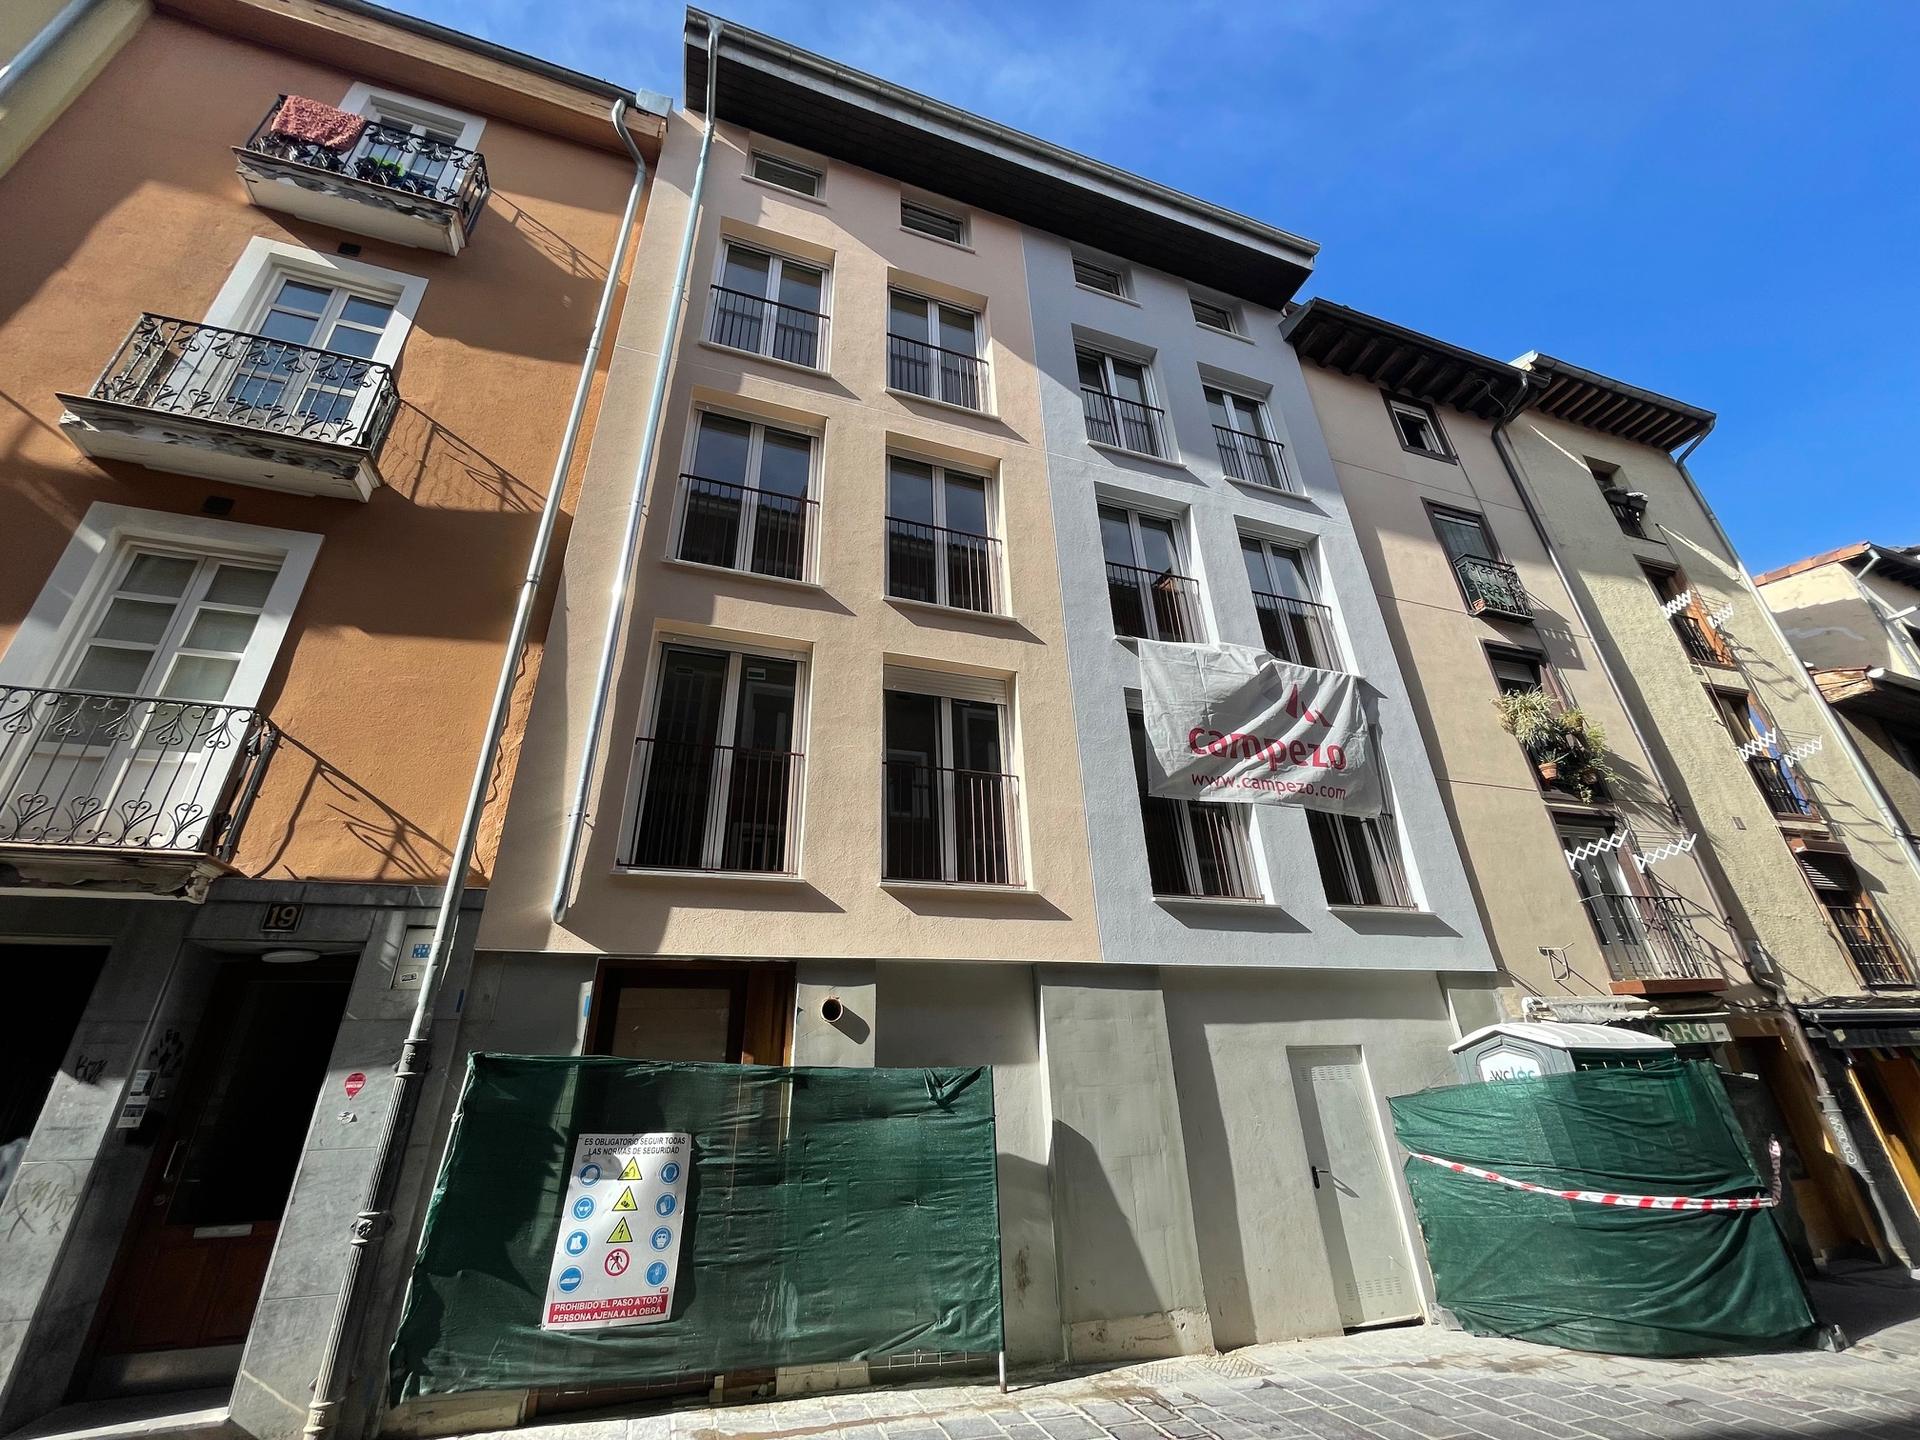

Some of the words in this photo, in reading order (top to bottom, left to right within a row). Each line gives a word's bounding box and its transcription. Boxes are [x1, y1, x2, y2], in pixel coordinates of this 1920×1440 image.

[1188, 727, 1347, 771] campezo
[1191, 772, 1347, 800] www.campezo.com
[266, 906, 298, 927] 19
[584, 1138, 593, 1146] ES
[594, 1138, 639, 1146] OBLIGATORIO
[640, 1137, 663, 1145] SEGUIR
[665, 1137, 686, 1145] TODAS
[588, 1148, 601, 1156] LAS
[603, 1147, 631, 1155] NORMAS
[632, 1147, 641, 1155] DE
[642, 1146, 680, 1154] SEGURIDAD
[554, 1301, 599, 1312] PROHIBIDO
[600, 1300, 611, 1308] EL
[612, 1298, 633, 1307] PASO
[642, 1296, 663, 1305] TODA
[552, 1313, 591, 1322] PERSONA
[592, 1310, 619, 1320] AJENA
[627, 1308, 637, 1316] LA
[639, 1306, 661, 1315] OBRA
